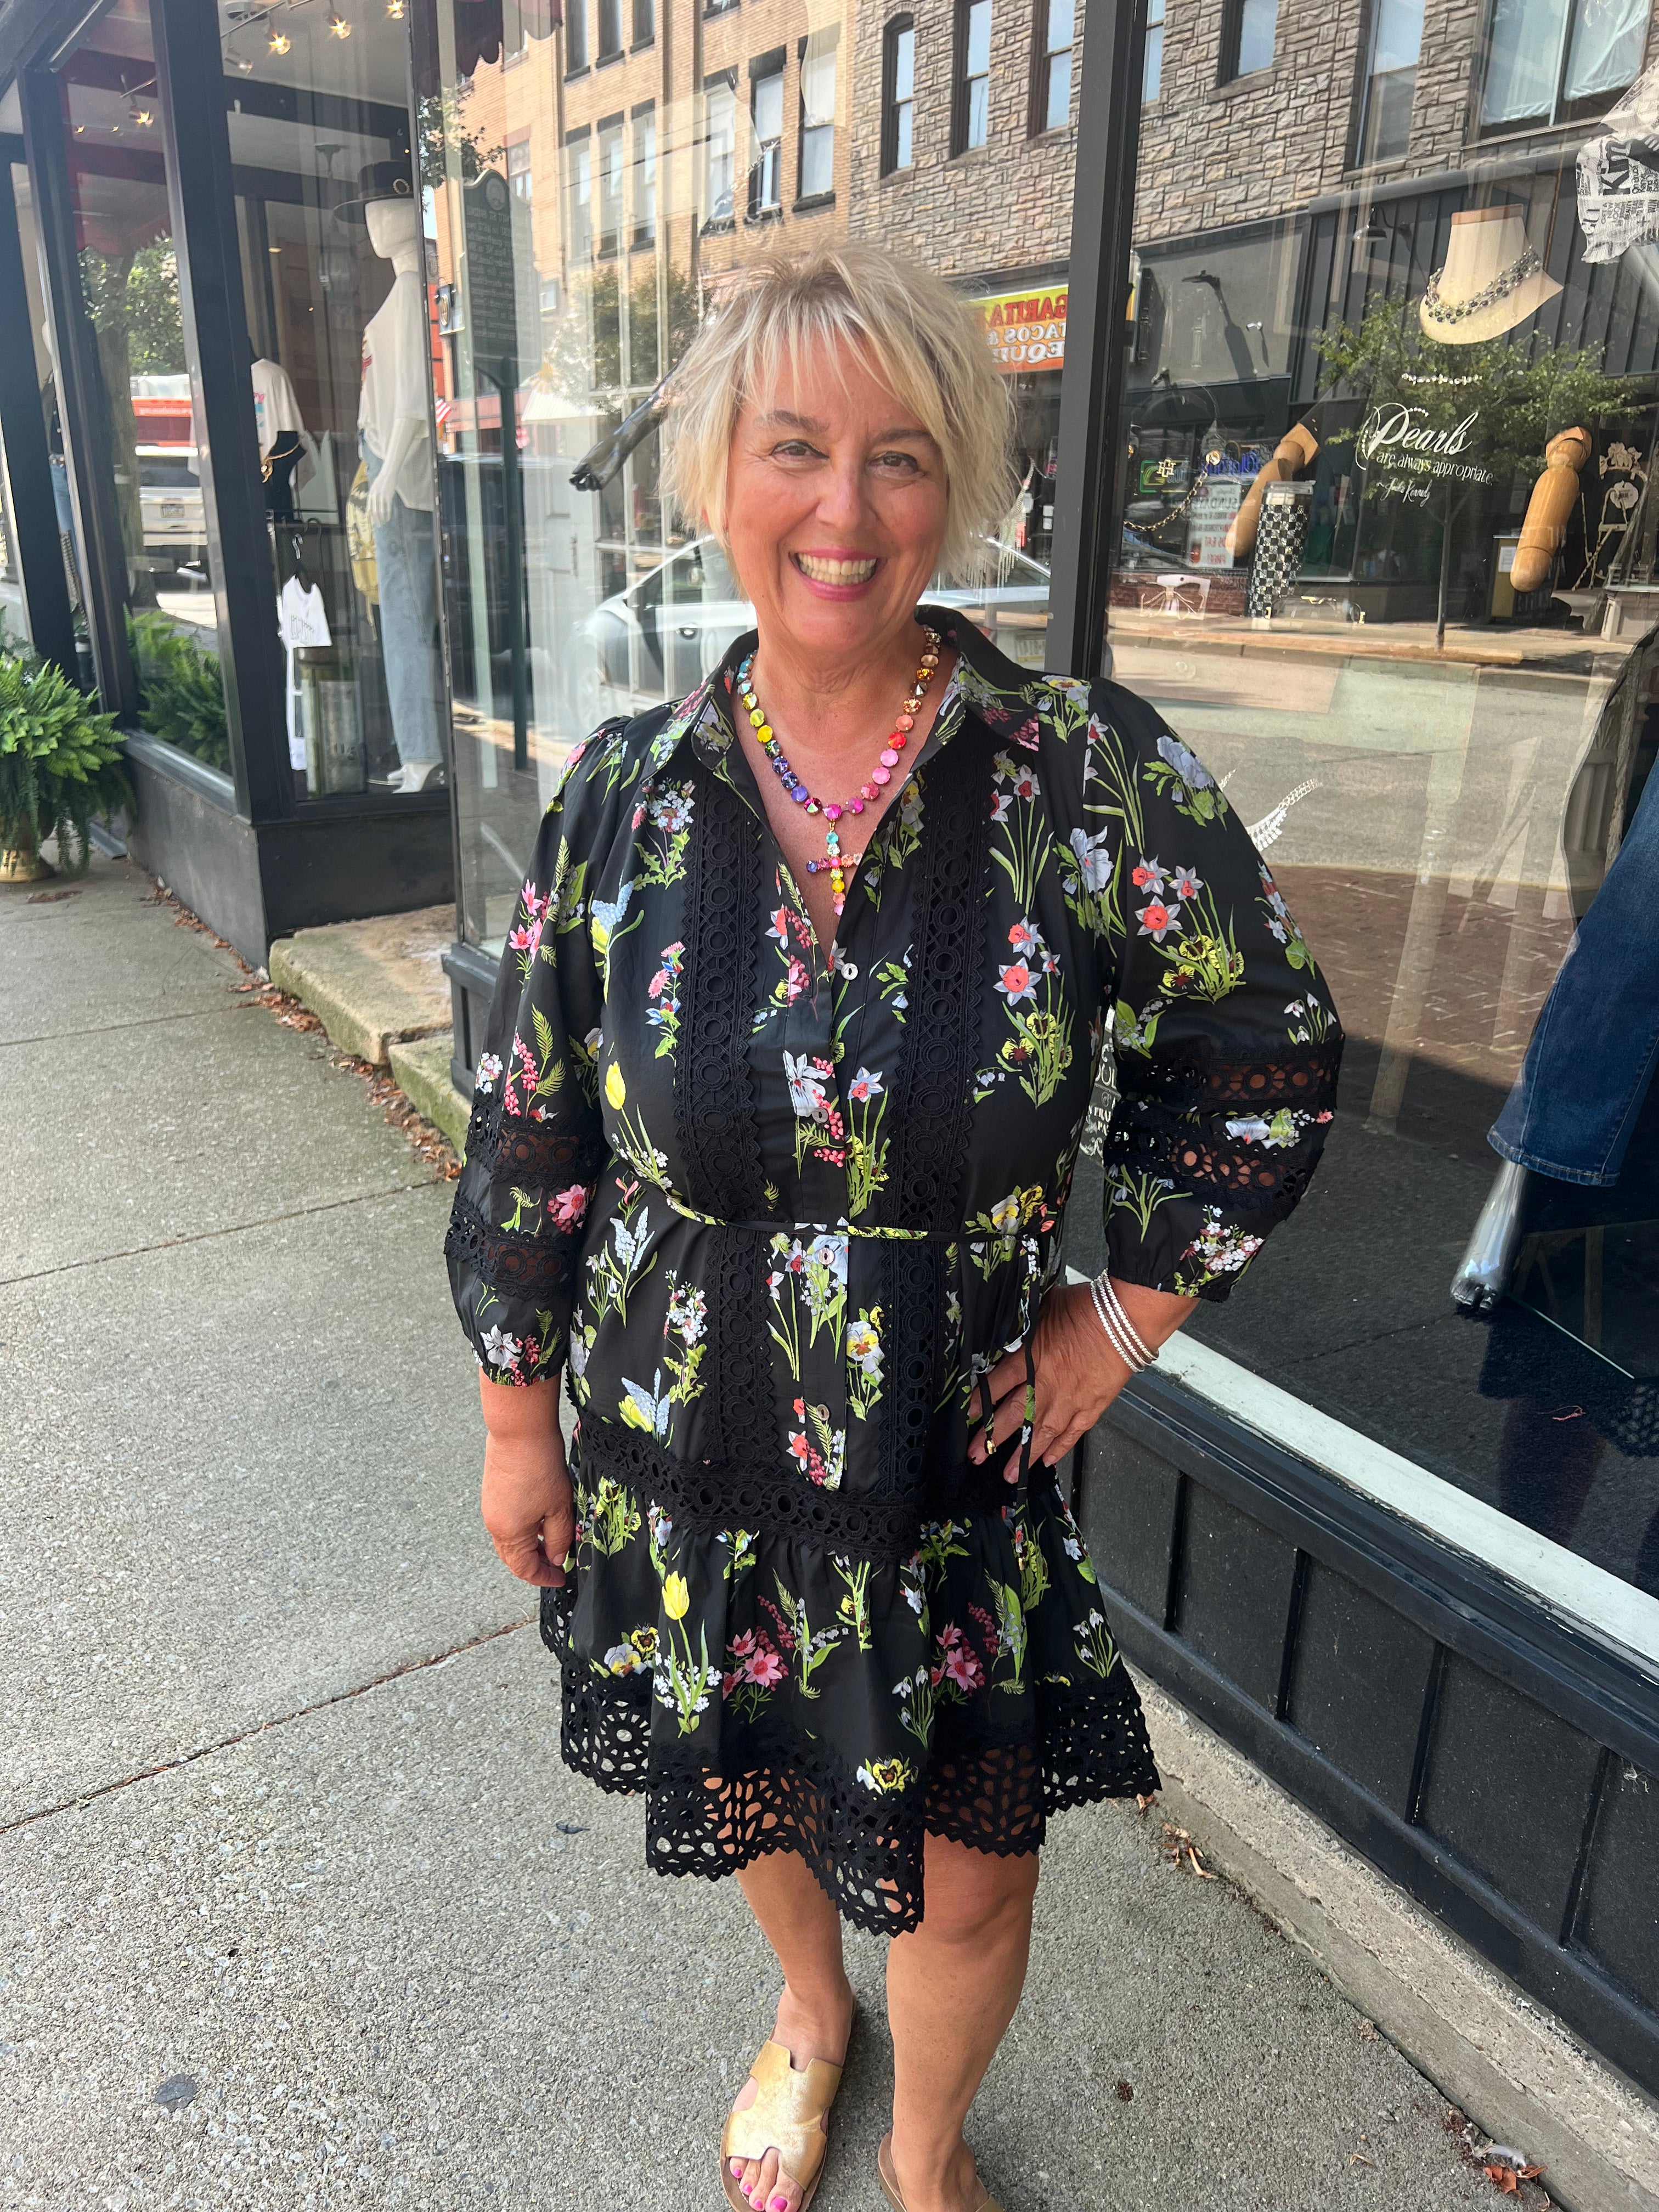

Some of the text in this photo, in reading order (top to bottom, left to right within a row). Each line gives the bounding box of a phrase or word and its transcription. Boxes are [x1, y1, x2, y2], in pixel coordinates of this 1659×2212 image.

[1355, 403, 1479, 470] Pearls
[1376, 450, 1494, 486] are always appropriate.
